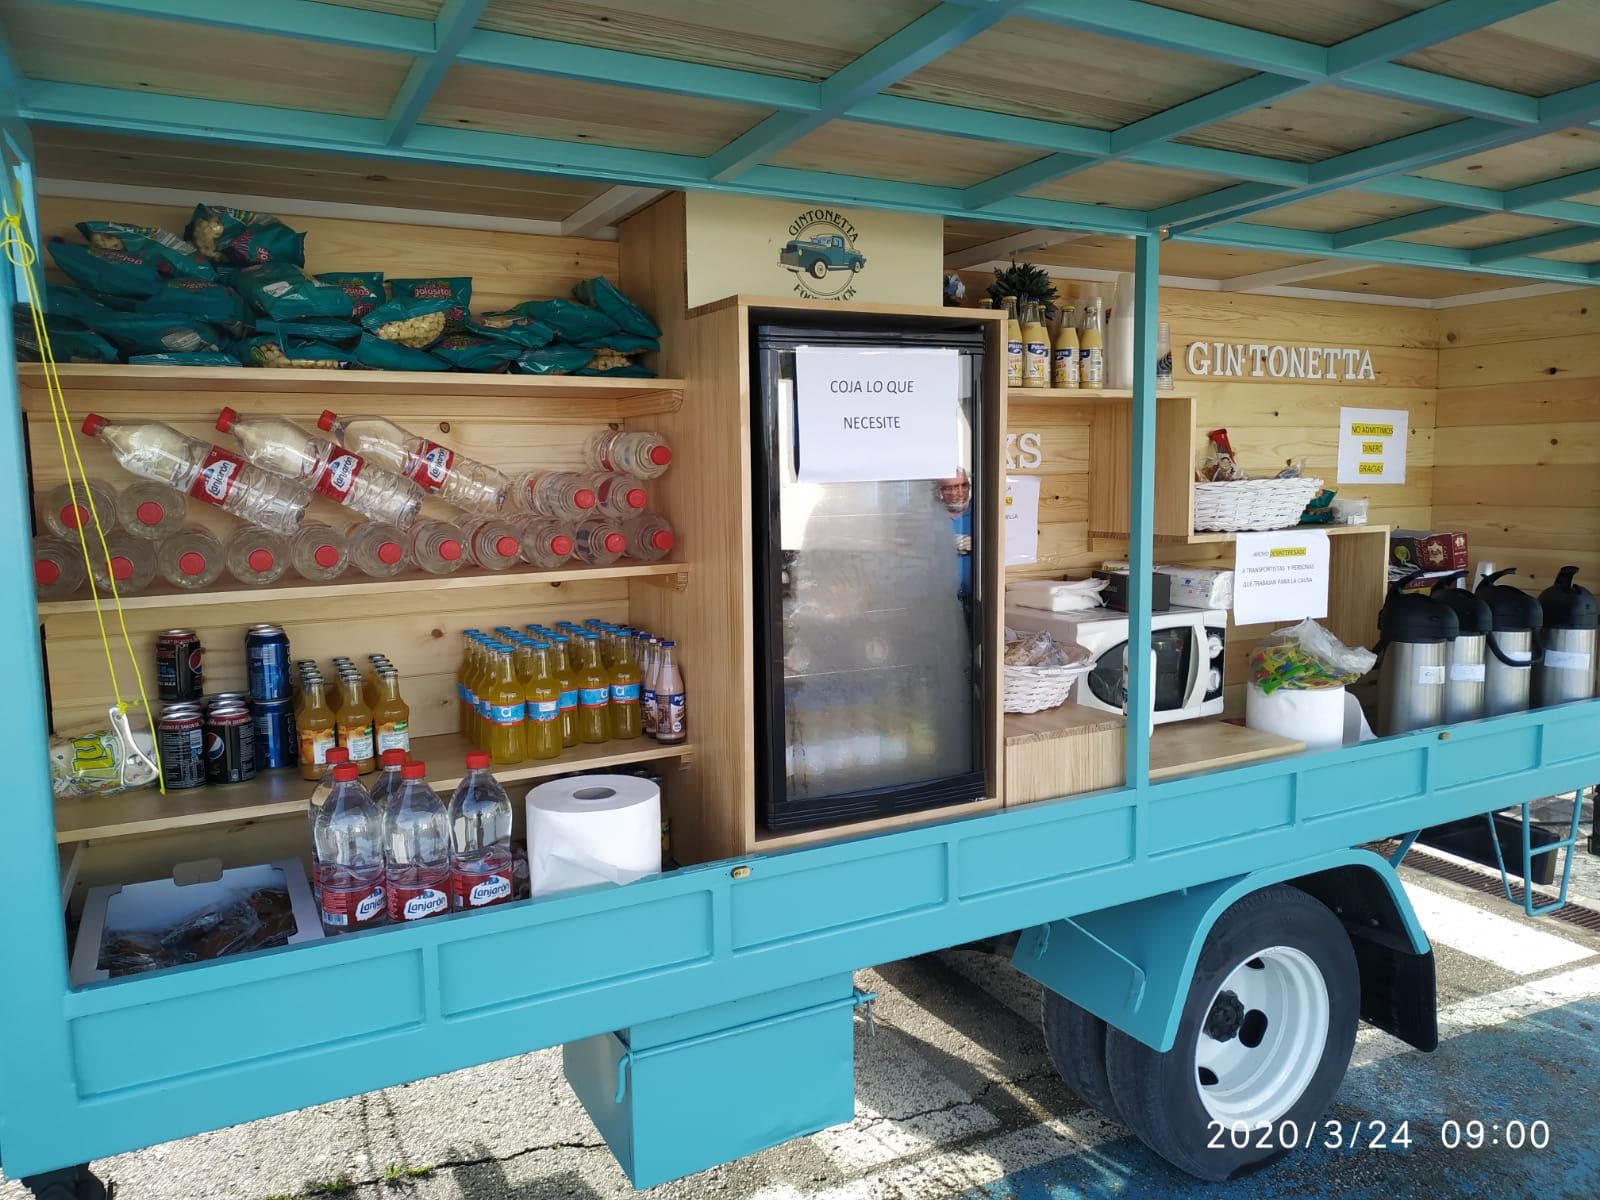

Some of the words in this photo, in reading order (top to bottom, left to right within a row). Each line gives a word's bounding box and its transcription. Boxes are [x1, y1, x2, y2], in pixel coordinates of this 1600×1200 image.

[788, 209, 859, 243] GINTONETTA
[830, 380, 862, 393] COJA
[866, 380, 883, 393] LO
[886, 380, 914, 394] QUE
[843, 416, 901, 430] NECESITE
[1352, 425, 1361, 434] NO
[1362, 425, 1394, 435] ADMITIMOS
[1362, 444, 1383, 454] DINERO
[1359, 464, 1384, 473] GRACIAS
[1246, 565, 1286, 573] TRANSPORTISTAS
[473, 882, 511, 900] Lanjarón
[359, 896, 386, 915] Lanjar
[407, 896, 447, 914] Lanjarón
